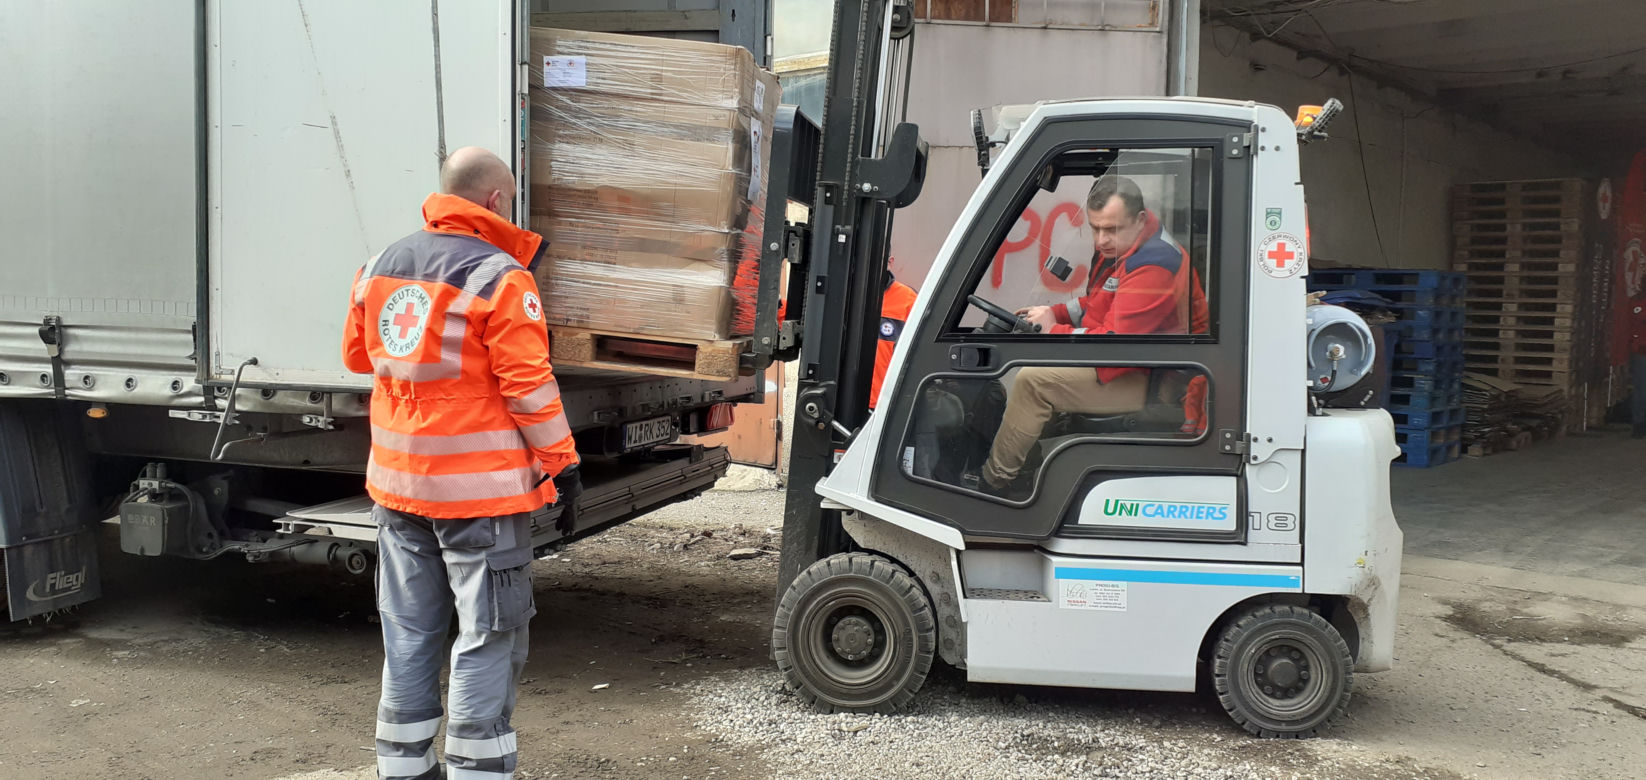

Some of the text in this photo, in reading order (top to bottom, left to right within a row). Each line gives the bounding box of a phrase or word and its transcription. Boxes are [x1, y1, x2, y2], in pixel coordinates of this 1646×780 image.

[386, 288, 430, 316] DEUTSCHES
[381, 319, 399, 352] ROTES
[399, 325, 423, 353] KREUZ
[655, 419, 670, 438] 352
[1248, 511, 1296, 531] 18
[45, 565, 86, 593] Fliegl
